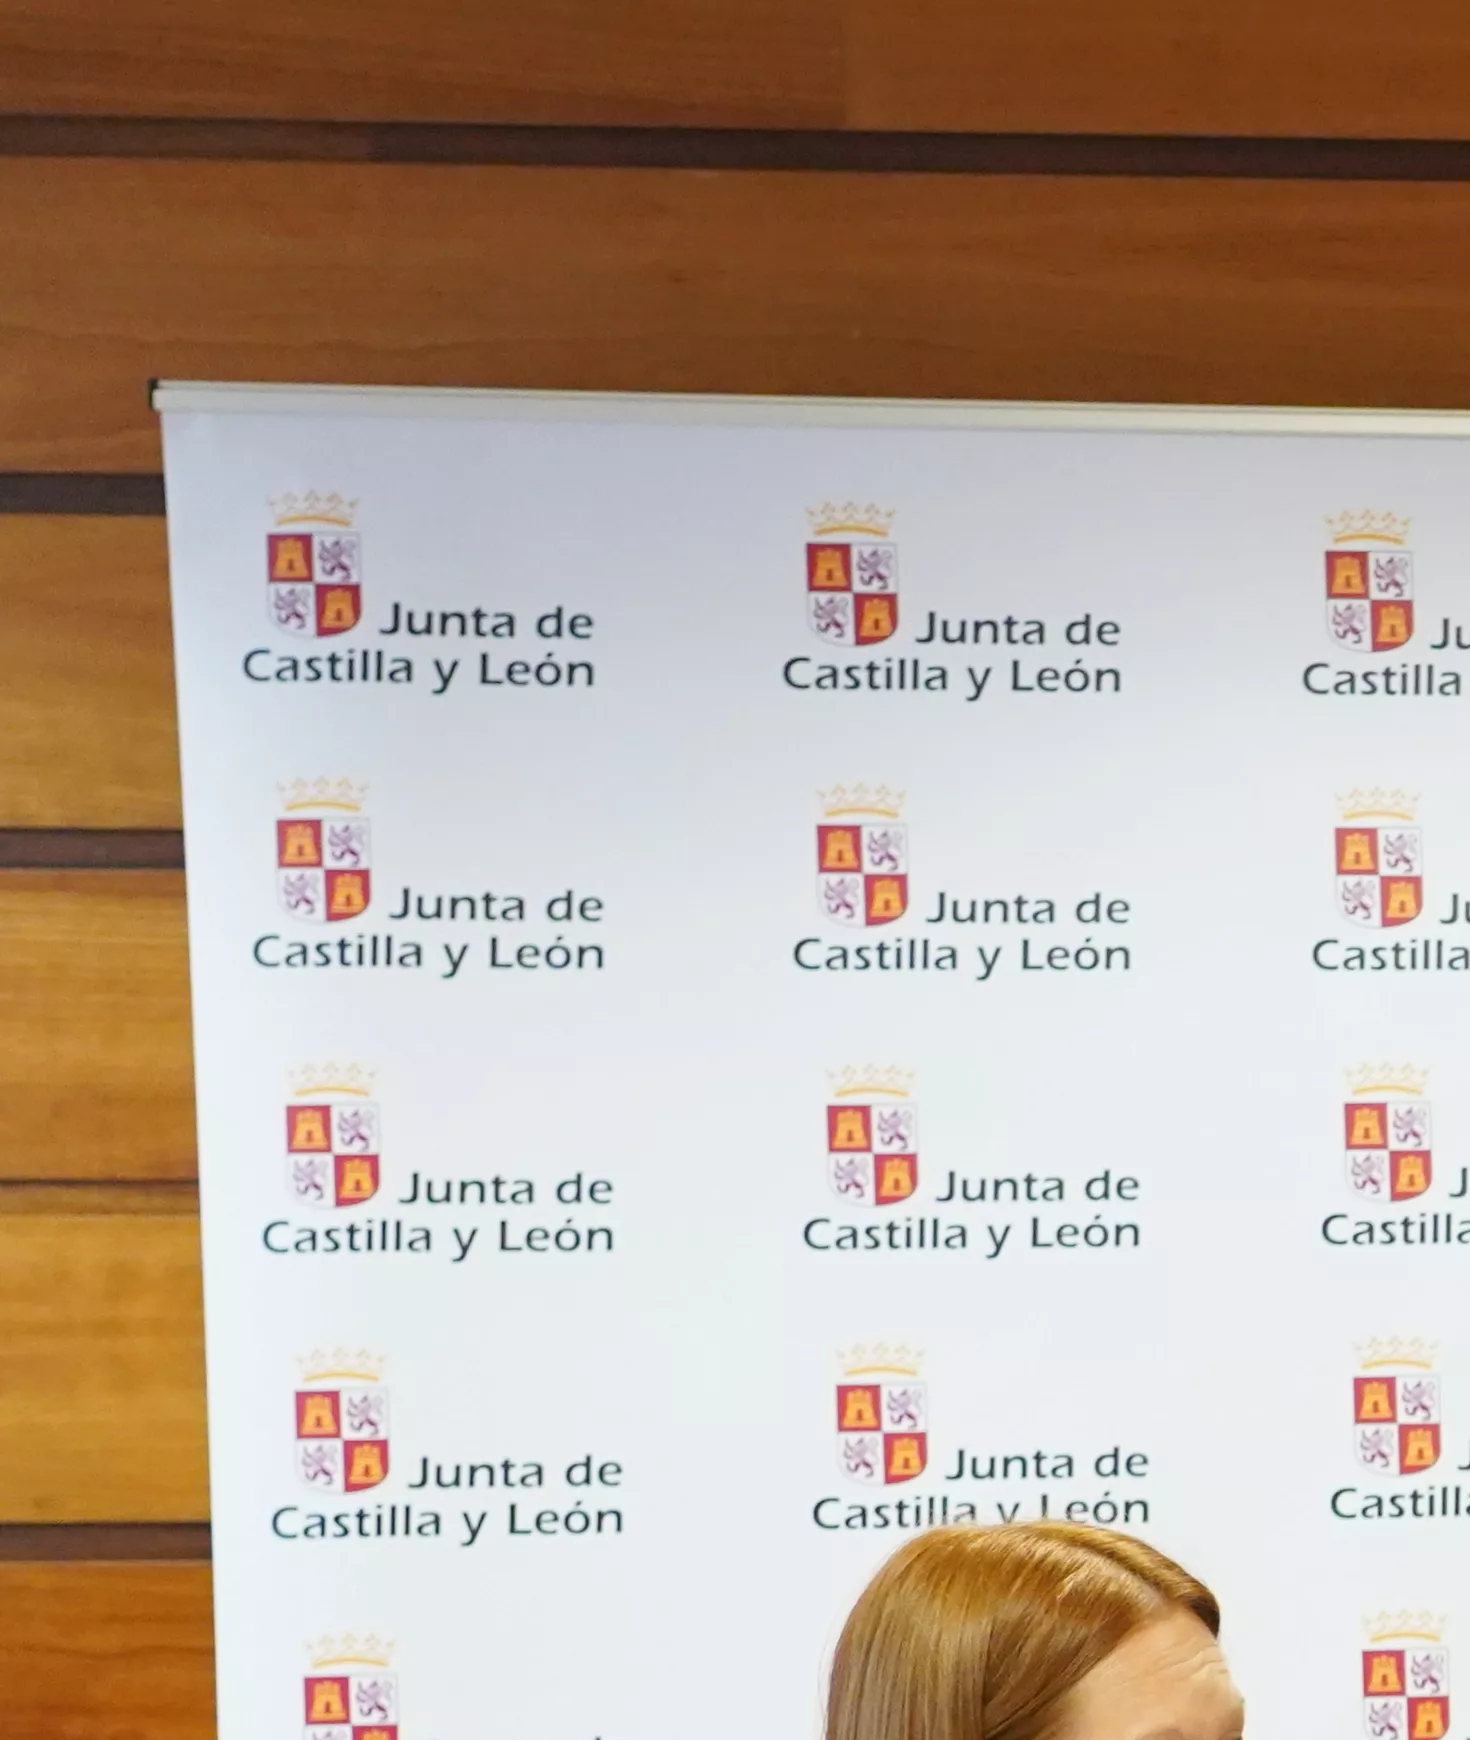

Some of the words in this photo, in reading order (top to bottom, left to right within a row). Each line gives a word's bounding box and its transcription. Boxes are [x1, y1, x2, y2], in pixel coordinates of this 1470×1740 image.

[380, 603, 515, 637] Junta
[537, 606, 593, 639] de
[916, 612, 1044, 644] Junta
[1066, 614, 1119, 645] de
[244, 650, 412, 682] Castilla
[433, 660, 458, 694] y
[481, 653, 593, 686] León
[784, 657, 947, 690] Castilla
[967, 668, 991, 701] y
[1012, 660, 1119, 691] León
[1304, 663, 1460, 695] Castilla
[391, 888, 523, 920] Junta
[547, 891, 602, 921] de
[928, 893, 1053, 923] Junta
[1077, 894, 1128, 922] de
[255, 936, 421, 966] Castilla
[444, 945, 467, 978] y
[491, 938, 602, 968] León
[794, 939, 956, 969] Castilla
[978, 948, 1000, 980] y
[1023, 940, 1129, 969] León
[1314, 940, 1468, 970] Castilla
[401, 1173, 533, 1203] Junta
[557, 1174, 612, 1203] de
[937, 1172, 1063, 1201] Junta
[1086, 1171, 1138, 1200] de
[264, 1221, 430, 1252] Castilla
[454, 1229, 476, 1261] y
[501, 1221, 612, 1250] León
[804, 1219, 966, 1249] Castilla
[988, 1226, 1010, 1258] y
[1033, 1218, 1138, 1247] León
[410, 1458, 542, 1487] Junta
[566, 1456, 621, 1485] de
[947, 1450, 1072, 1479] Junta
[1095, 1448, 1147, 1476] de
[273, 1506, 440, 1537] Castilla
[463, 1513, 486, 1545] y
[510, 1504, 621, 1533] León
[813, 1496, 977, 1529] Castilla
[996, 1501, 1021, 1523] y
[1041, 1492, 1149, 1524] León
